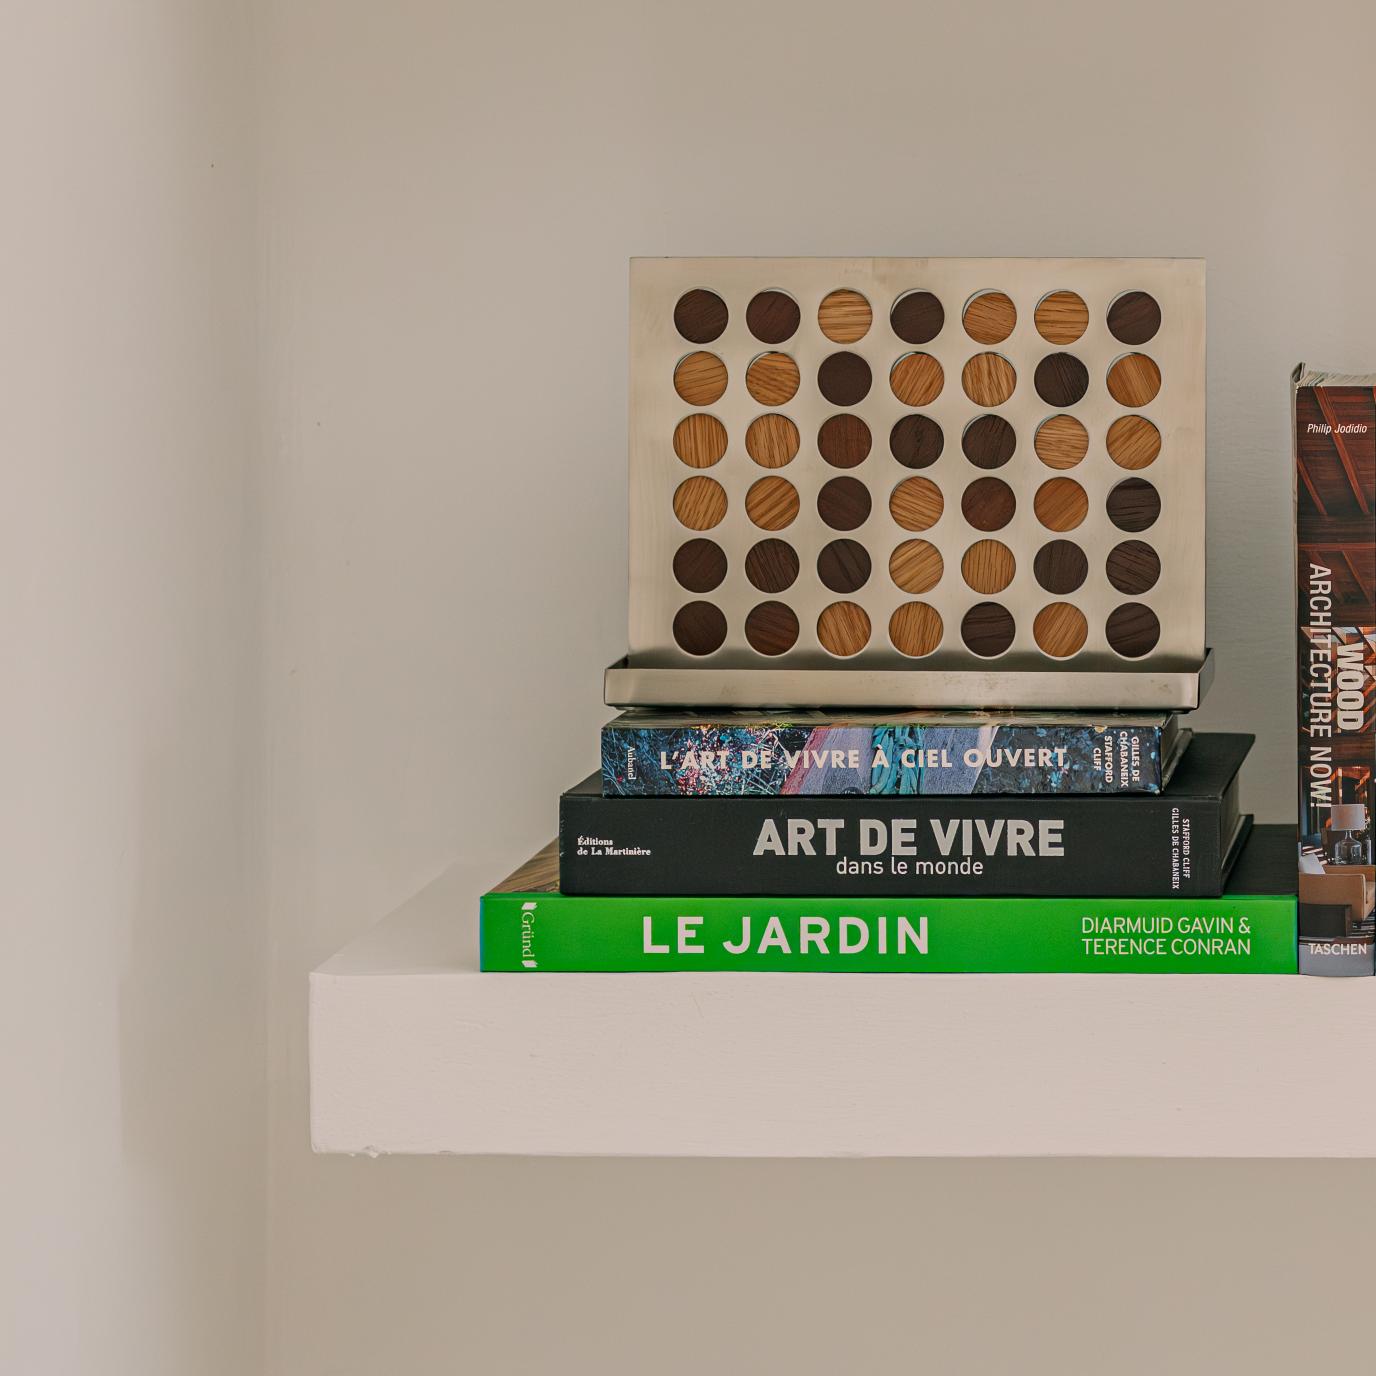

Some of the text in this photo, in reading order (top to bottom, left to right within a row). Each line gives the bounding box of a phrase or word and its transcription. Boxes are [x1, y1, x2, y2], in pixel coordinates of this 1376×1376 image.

[1307, 423, 1368, 435] Philip Jodidio
[1308, 562, 1333, 808] ARCHITECTURE NOW!
[1336, 642, 1365, 731] WOOD
[660, 743, 1068, 771] L'ART DE VIVRE À CIEL OUVERT
[1092, 747, 1102, 772] CLIFF
[1103, 735, 1113, 784] STAFFORD
[1119, 730, 1129, 788] CHABANEIX
[1131, 735, 1141, 783] GILLES DE
[577, 835, 614, 846] Éditions
[577, 846, 652, 856] de La Martinière
[752, 818, 1065, 857] ART DE VIVRE
[1171, 807, 1180, 890] GILLES DE CHABANEIX
[1182, 818, 1191, 879] STAFFORD CLIFF
[836, 856, 984, 876] dans le monde
[521, 911, 536, 957] Gründ
[642, 915, 929, 954] LE JARDIN
[1081, 916, 1251, 934] DIARMUID GAVIN &
[1081, 938, 1251, 955] TERENCE CONRAN
[1308, 942, 1367, 956] TASCHEN
